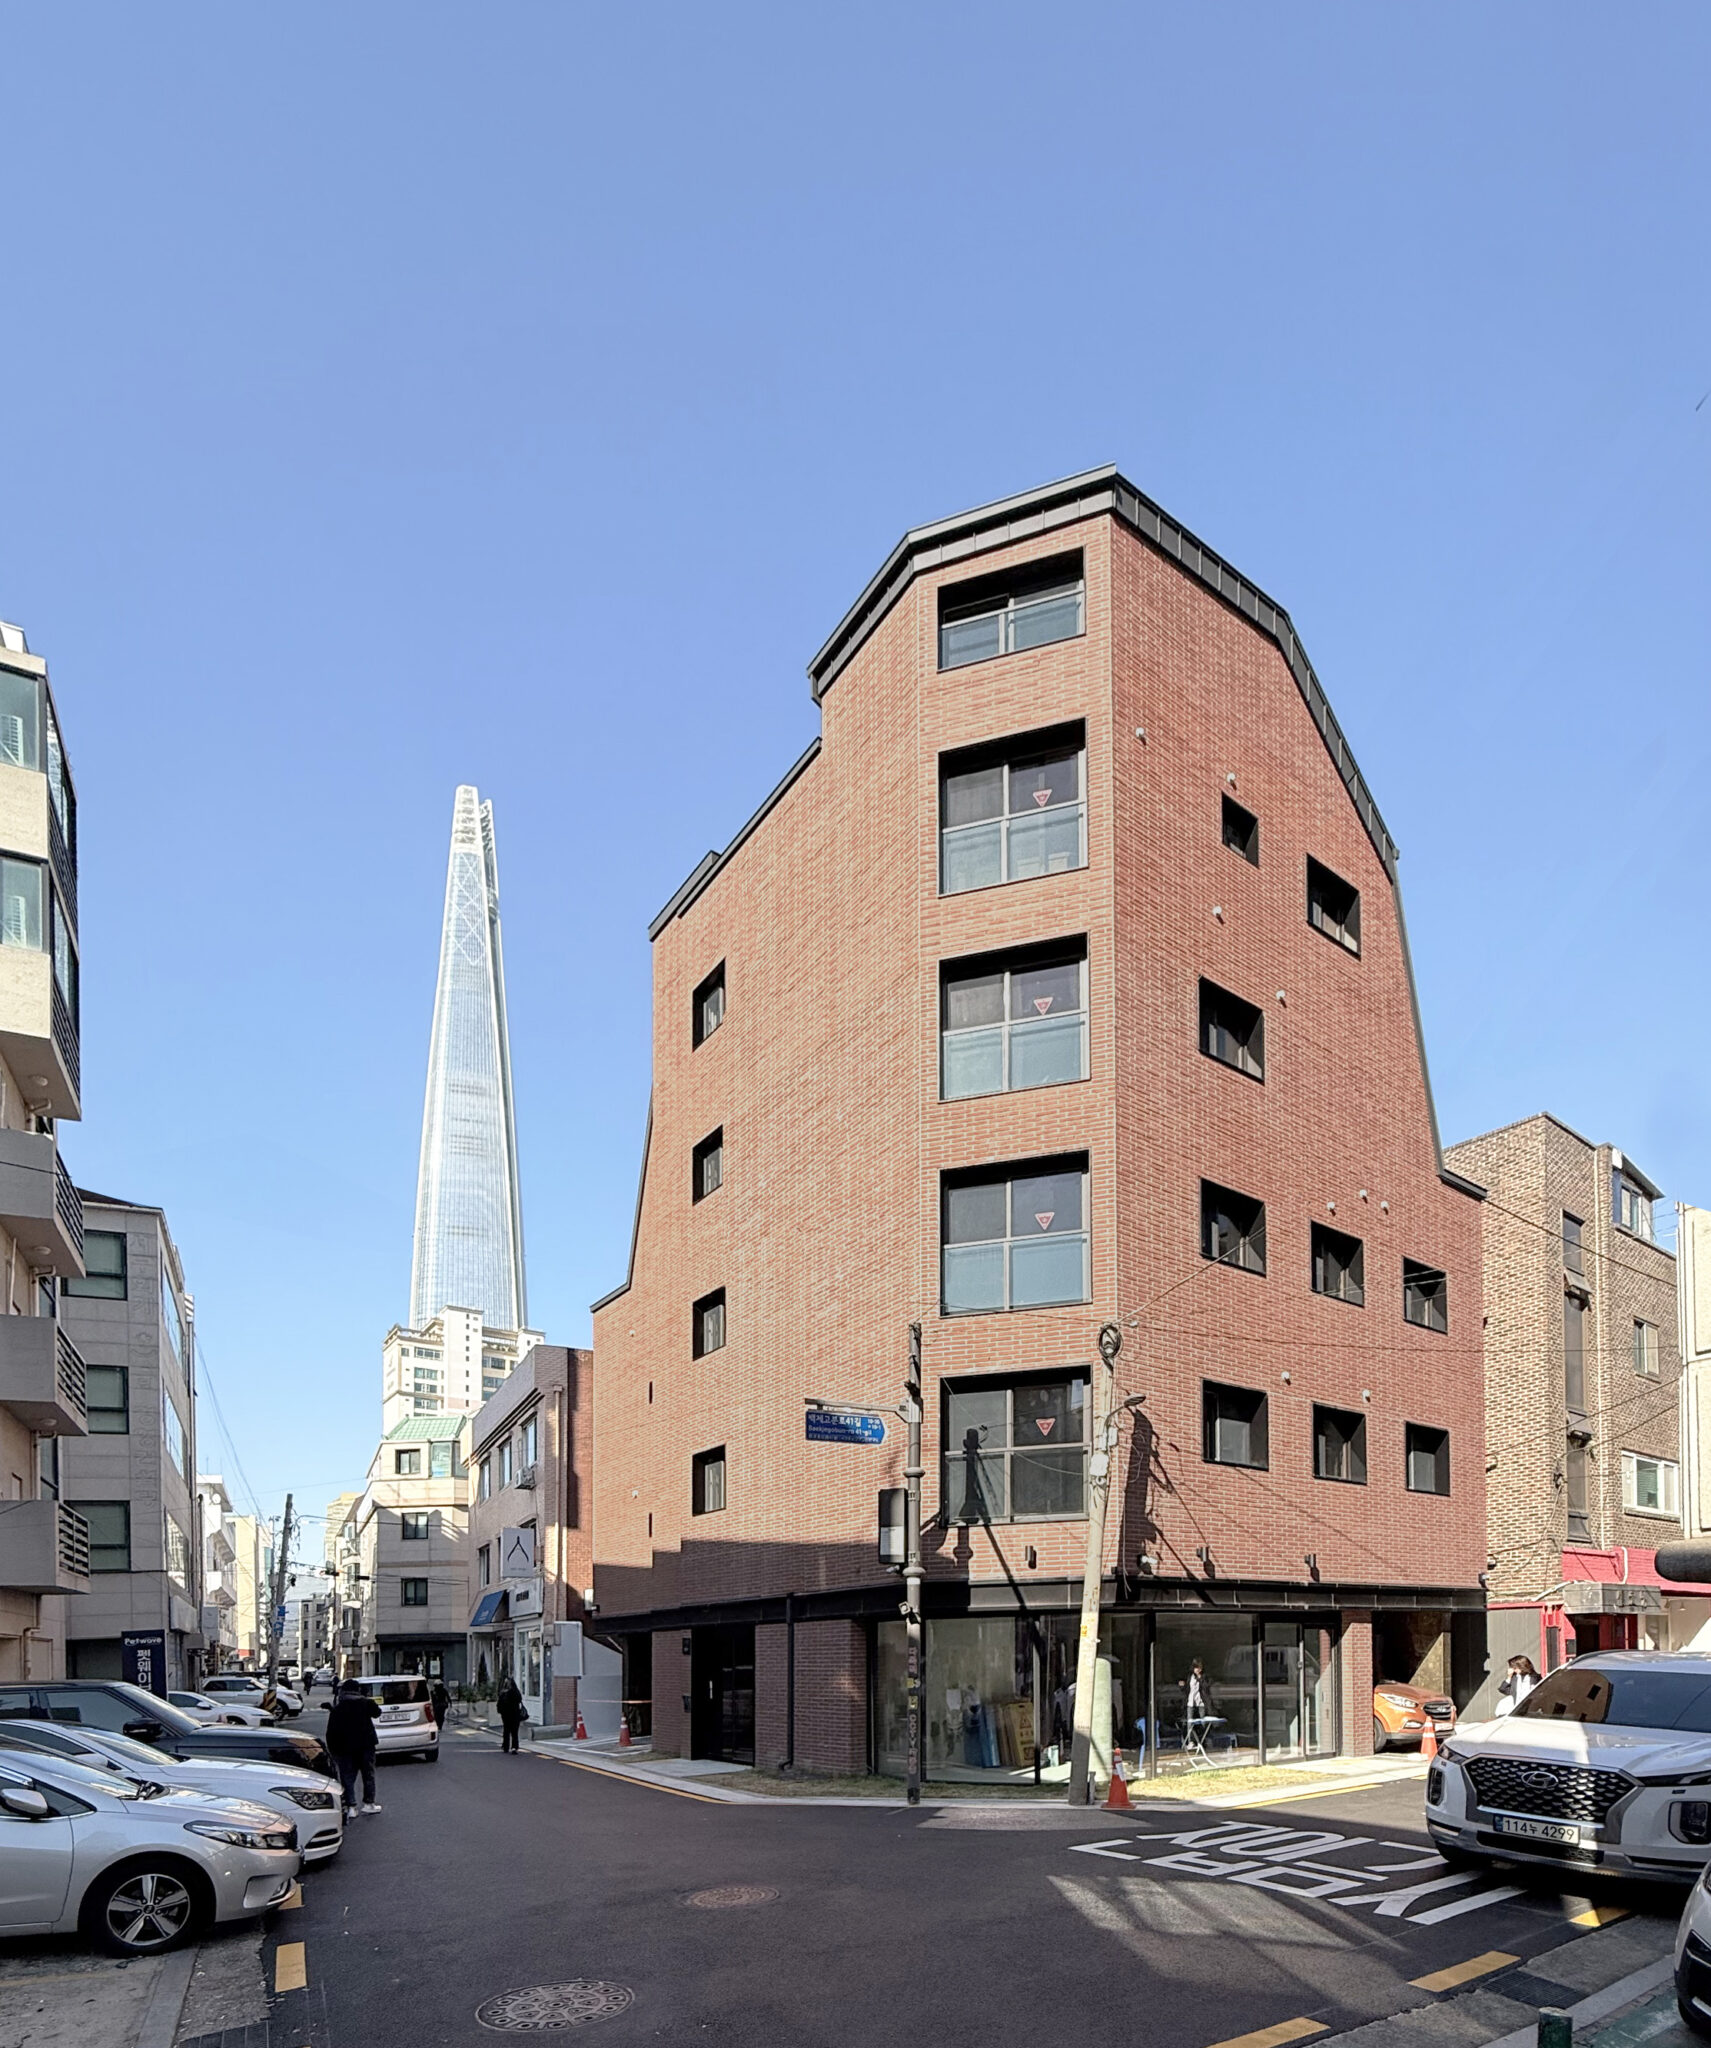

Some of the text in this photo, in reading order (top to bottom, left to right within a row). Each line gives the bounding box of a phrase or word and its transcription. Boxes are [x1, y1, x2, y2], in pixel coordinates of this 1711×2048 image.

[808, 1413, 862, 1428] 백제고분로41길
[124, 1637, 162, 1646] Petwave
[1504, 1819, 1575, 1841] 114누 4299
